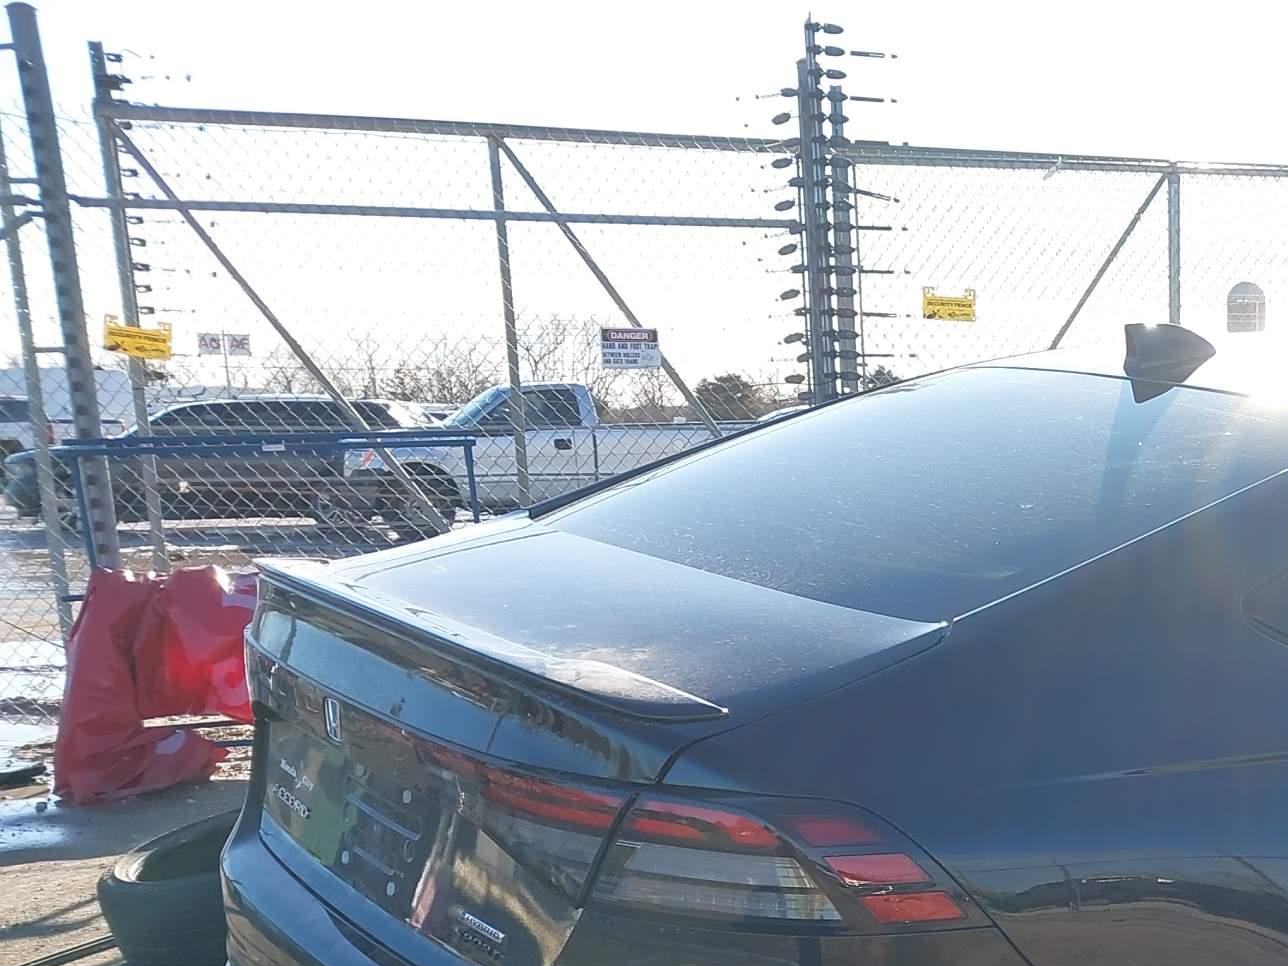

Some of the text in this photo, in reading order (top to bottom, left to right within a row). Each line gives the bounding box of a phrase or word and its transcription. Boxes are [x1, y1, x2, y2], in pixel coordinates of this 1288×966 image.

[610, 332, 649, 340] DANGER
[272, 784, 311, 818] ACCORD
[466, 915, 502, 942] HYBRID
